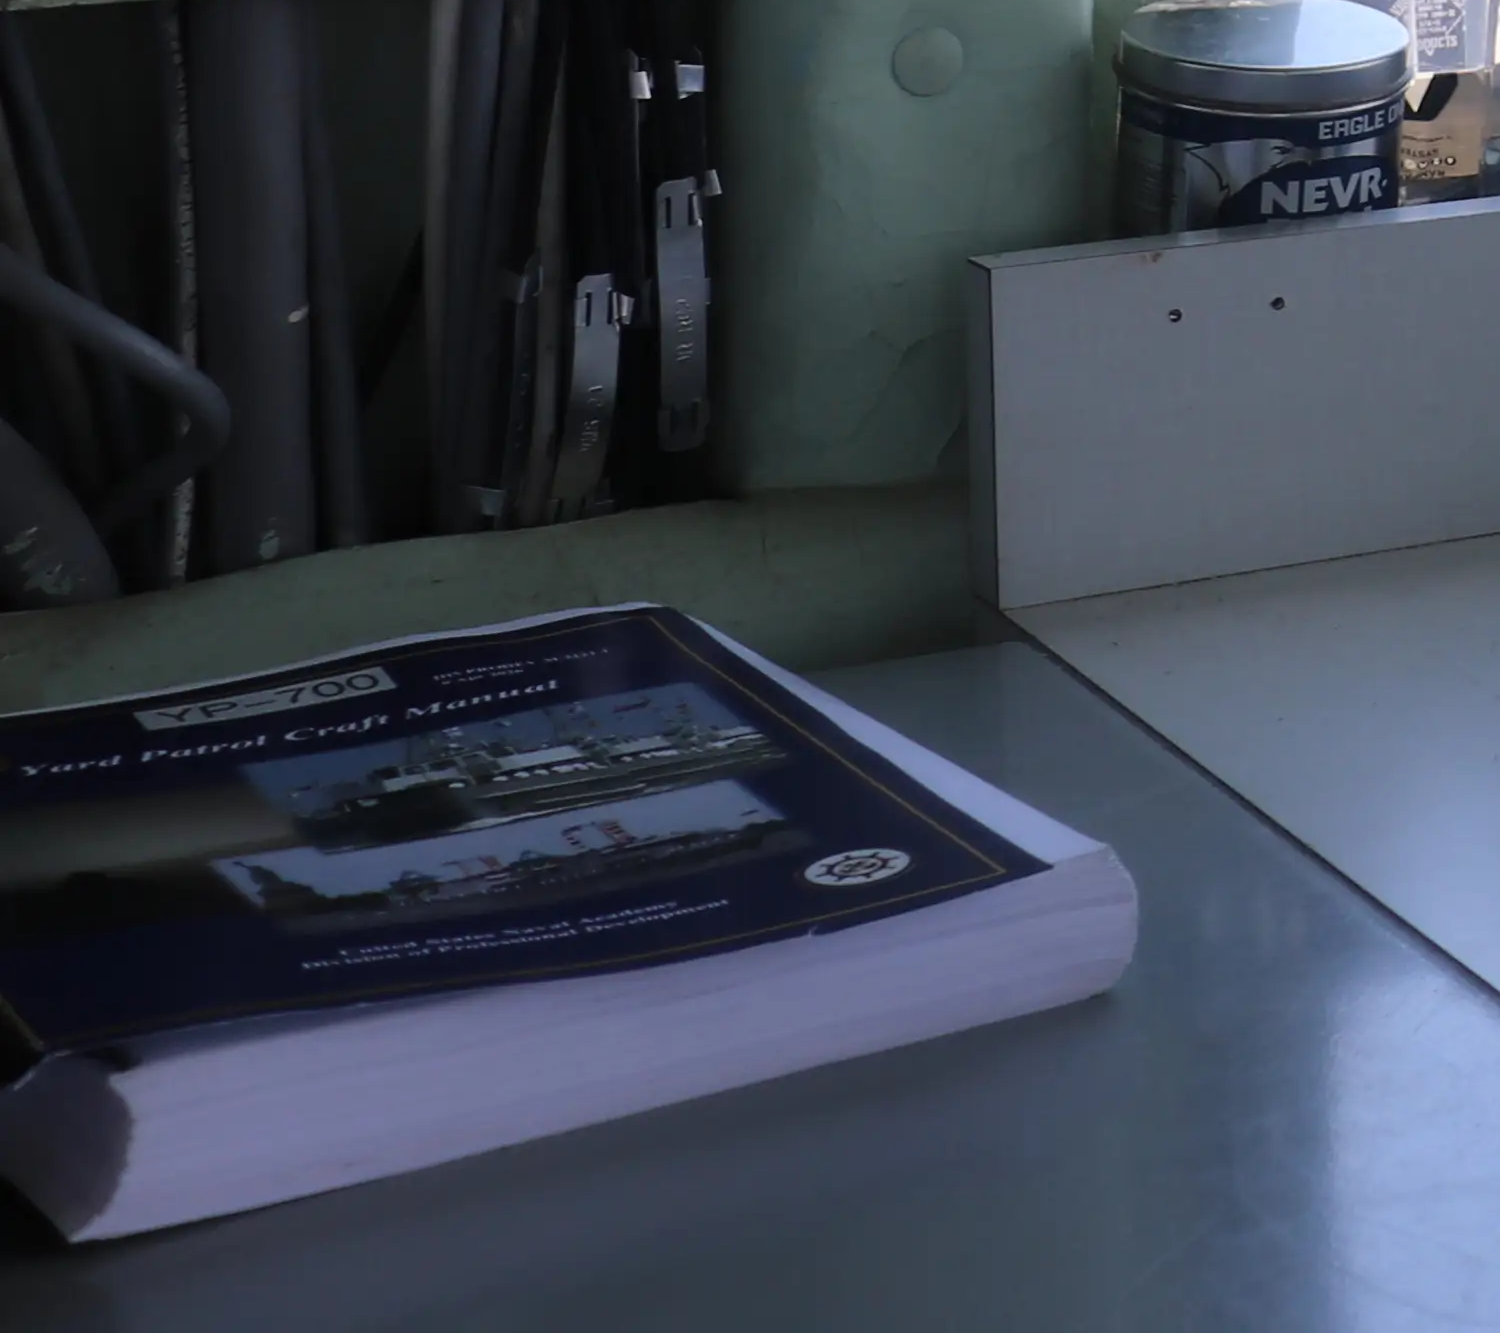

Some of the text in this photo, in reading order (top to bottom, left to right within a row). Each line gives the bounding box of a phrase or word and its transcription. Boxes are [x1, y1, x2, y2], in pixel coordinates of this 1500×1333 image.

[1318, 109, 1385, 141] EAGLE
[19, 678, 561, 779] Yard Patrol Craft Manual
[301, 951, 400, 970] Division
[437, 928, 577, 954] Professional
[585, 898, 729, 934] Development
[338, 901, 677, 957] United States Naval Academy
